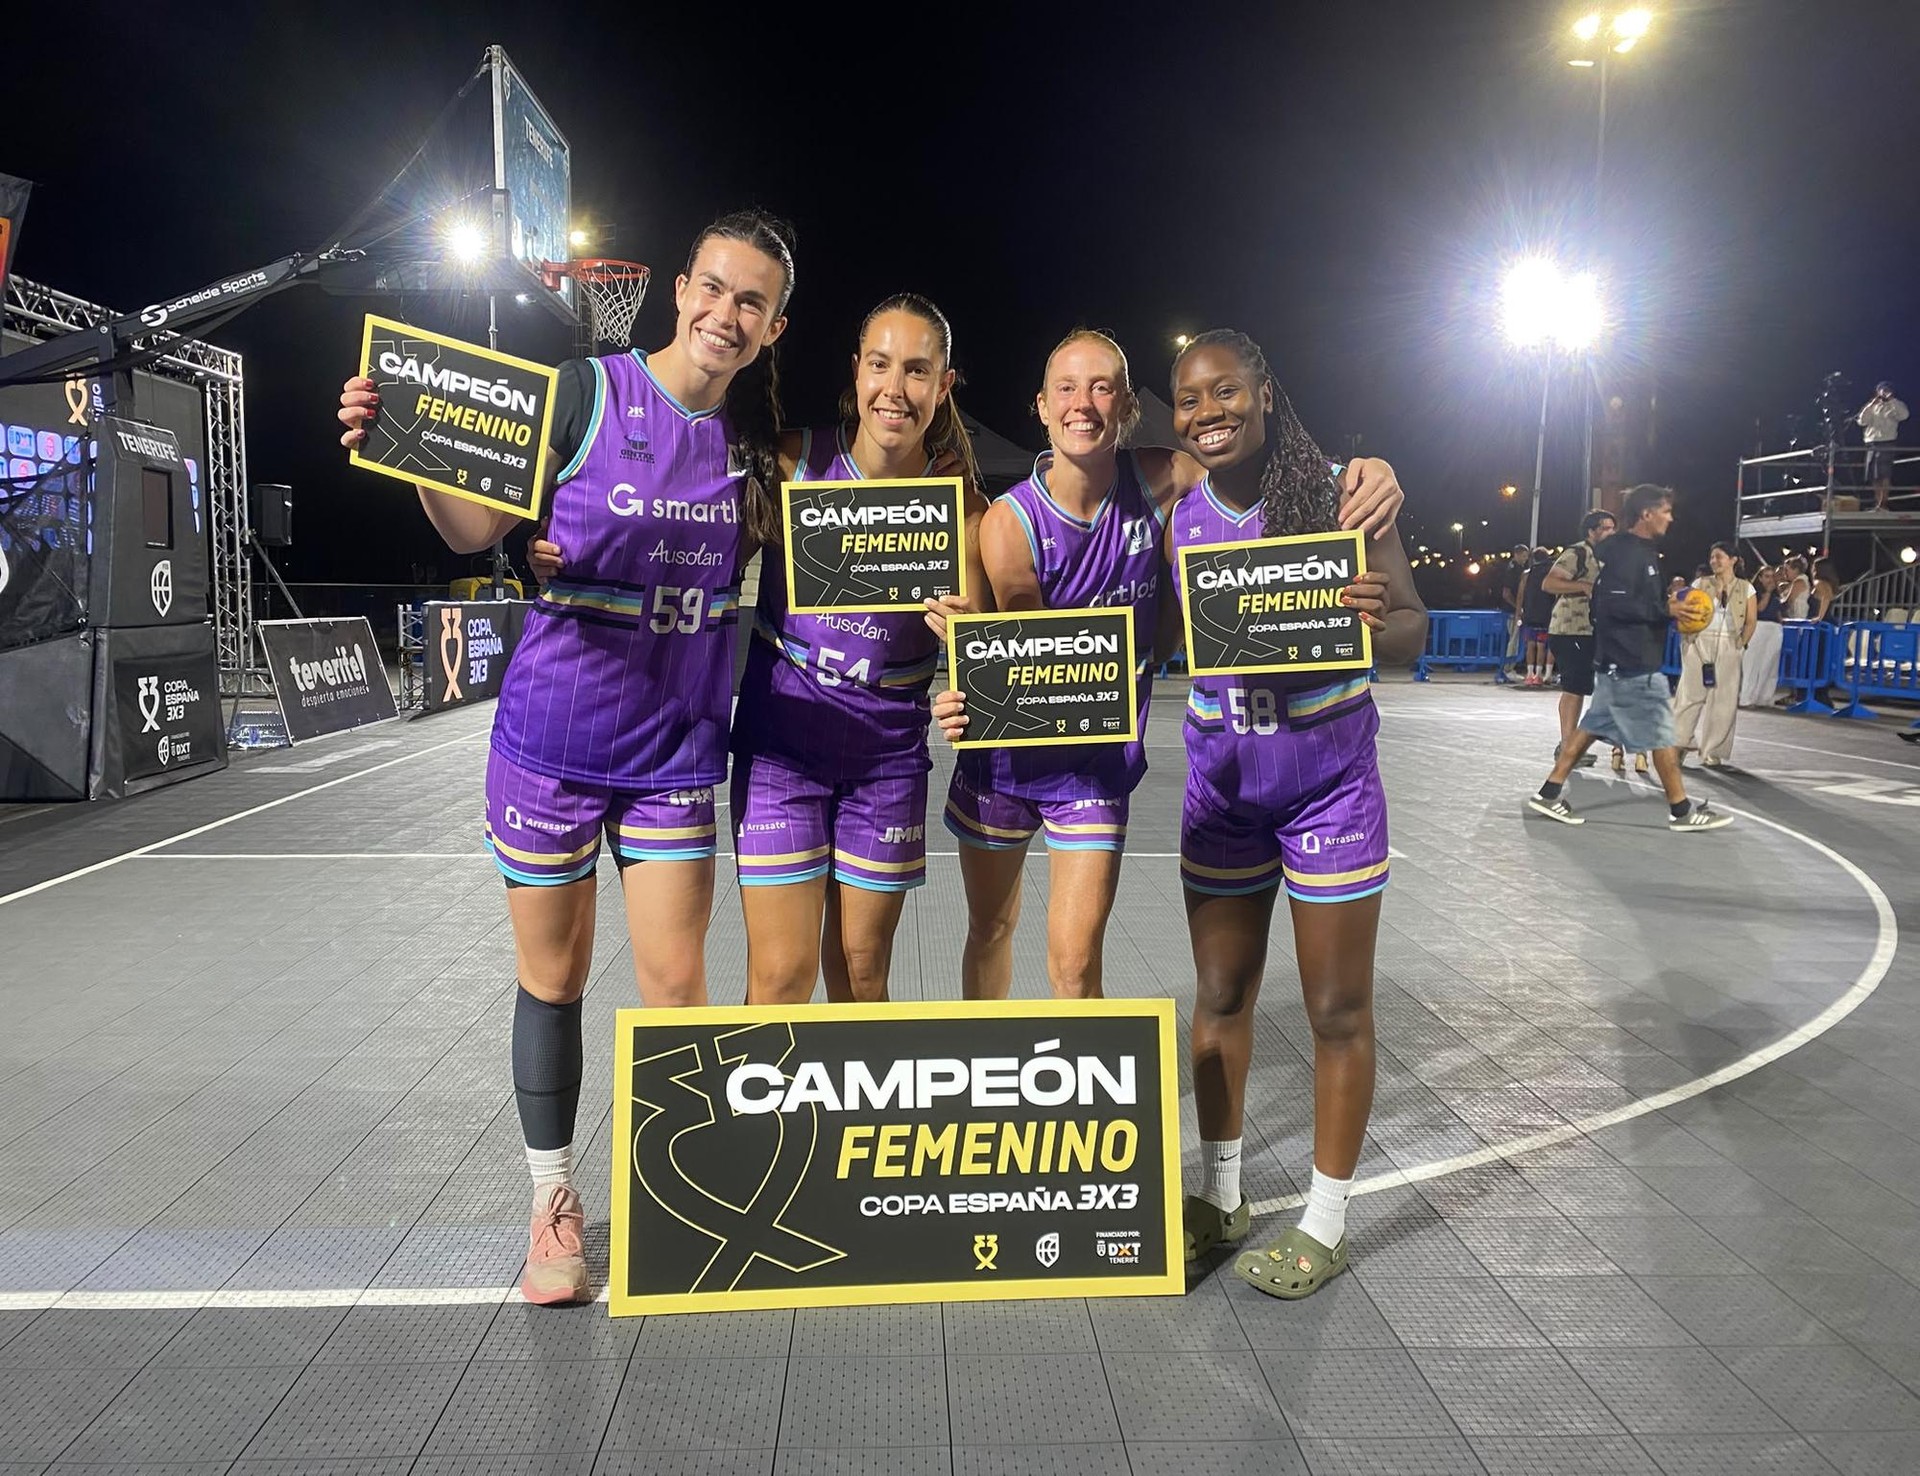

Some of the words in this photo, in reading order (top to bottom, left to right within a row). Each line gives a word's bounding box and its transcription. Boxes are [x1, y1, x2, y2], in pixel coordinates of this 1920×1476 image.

[221, 271, 267, 293] Sports
[378, 351, 537, 417] CAMPEÓN
[414, 394, 532, 447] FEMENINO
[116, 431, 178, 463] TENERIFE
[420, 430, 454, 448] COPA
[453, 440, 502, 463] ESPAÑA
[502, 452, 528, 470] 3X3
[799, 498, 948, 527] CAMPEÓN
[841, 531, 949, 554] FEMENINO
[850, 564, 880, 573] COPA
[881, 561, 926, 572] ESPAÑA
[927, 560, 950, 571] 3X3
[1196, 554, 1348, 590] CAMPEÓN
[648, 585, 704, 634] 59
[467, 618, 492, 638] COPA
[1247, 623, 1279, 633] COPA
[1279, 619, 1326, 632] ESPAÑA
[1327, 617, 1352, 628] 3X3
[468, 633, 503, 659] ESPAÑA
[965, 629, 1118, 660] CAMPEÓN
[469, 658, 488, 685] 3X3
[816, 646, 871, 688] 54
[1007, 662, 1119, 686] FEMENINO
[164, 679, 189, 694] COPA
[165, 689, 200, 706] ESPAÑA
[1016, 696, 1048, 705] COPA
[1048, 693, 1095, 704] ESPAÑA
[1095, 691, 1119, 702] 3X3
[301, 690, 335, 708] despierta
[166, 704, 185, 722] 3X3
[1227, 688, 1279, 736] 58
[176, 742, 191, 756] DXT
[525, 817, 572, 832] Arrasate
[746, 821, 787, 832] Arrasate
[1324, 832, 1365, 847] Arrasate
[726, 1038, 1137, 1115] CAMPEÓN
[836, 1119, 1138, 1180] FEMENINO
[859, 1195, 944, 1217] COPA
[949, 1186, 1073, 1214] ESPAÑA
[1076, 1184, 1140, 1210] 3X3
[1108, 1242, 1141, 1257] DXT
[1109, 1256, 1140, 1264] TENERIFE
